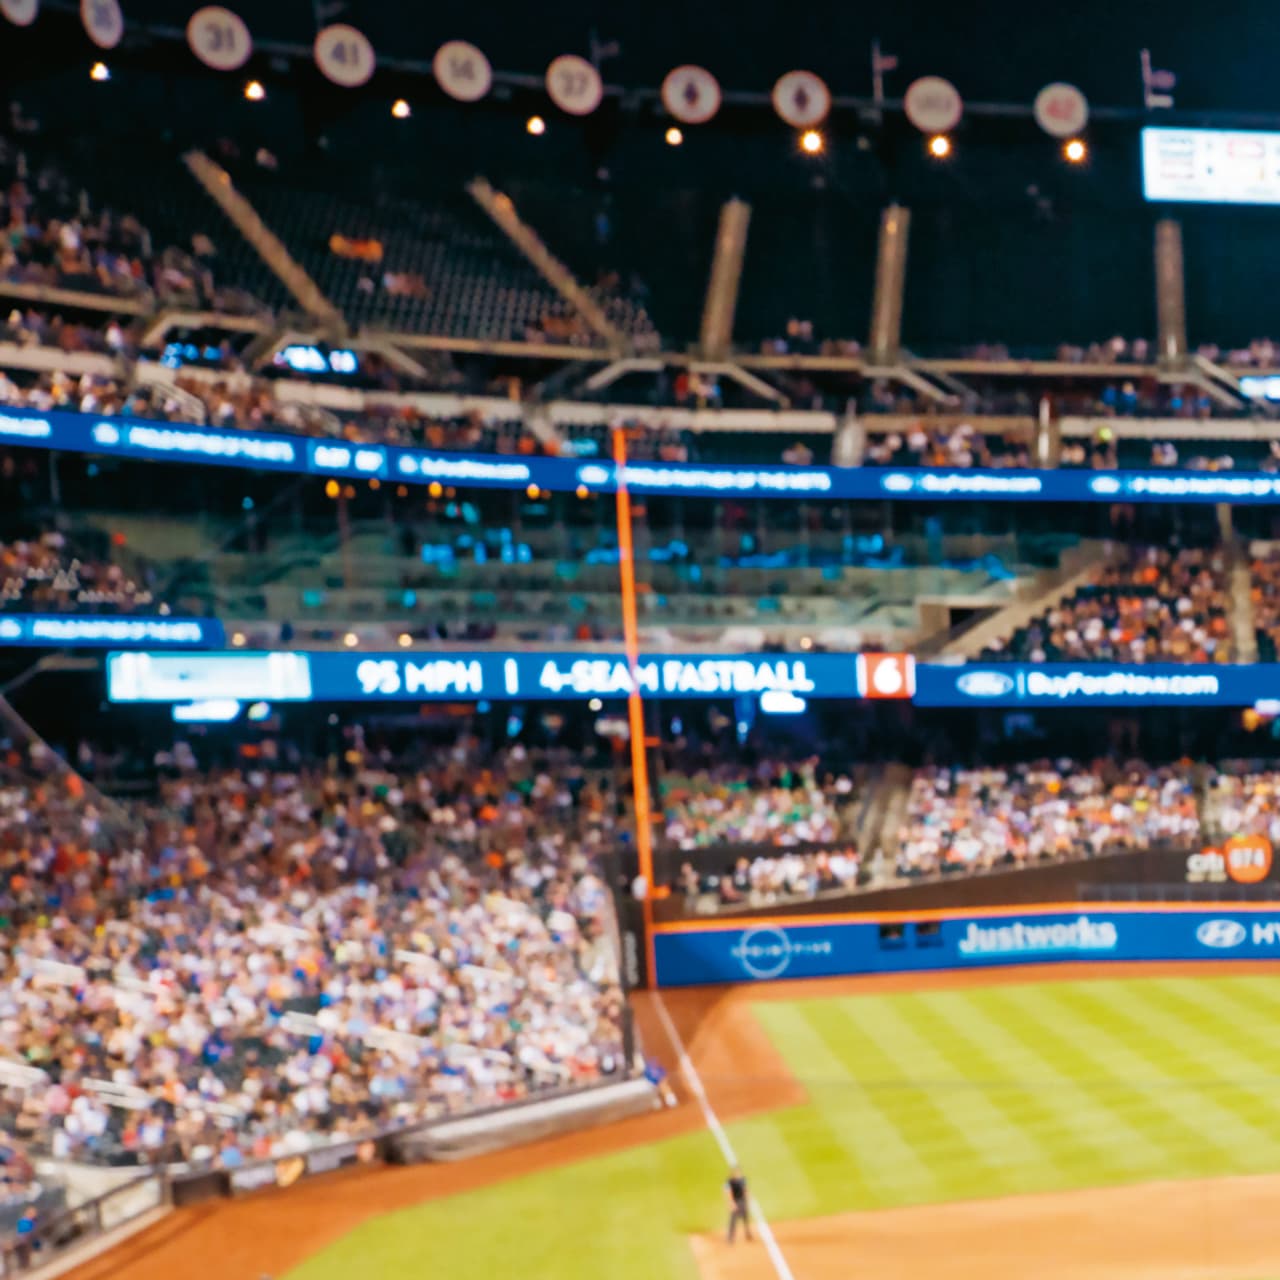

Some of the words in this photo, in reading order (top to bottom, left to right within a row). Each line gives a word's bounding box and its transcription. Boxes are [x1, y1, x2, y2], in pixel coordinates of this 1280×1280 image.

[331, 40, 361, 67] 41
[404, 660, 483, 694] MPH
[539, 659, 659, 694] 4-SEAM
[663, 660, 815, 693] FASTBALL
[872, 658, 903, 694] 6
[959, 916, 1118, 952] Justworks
